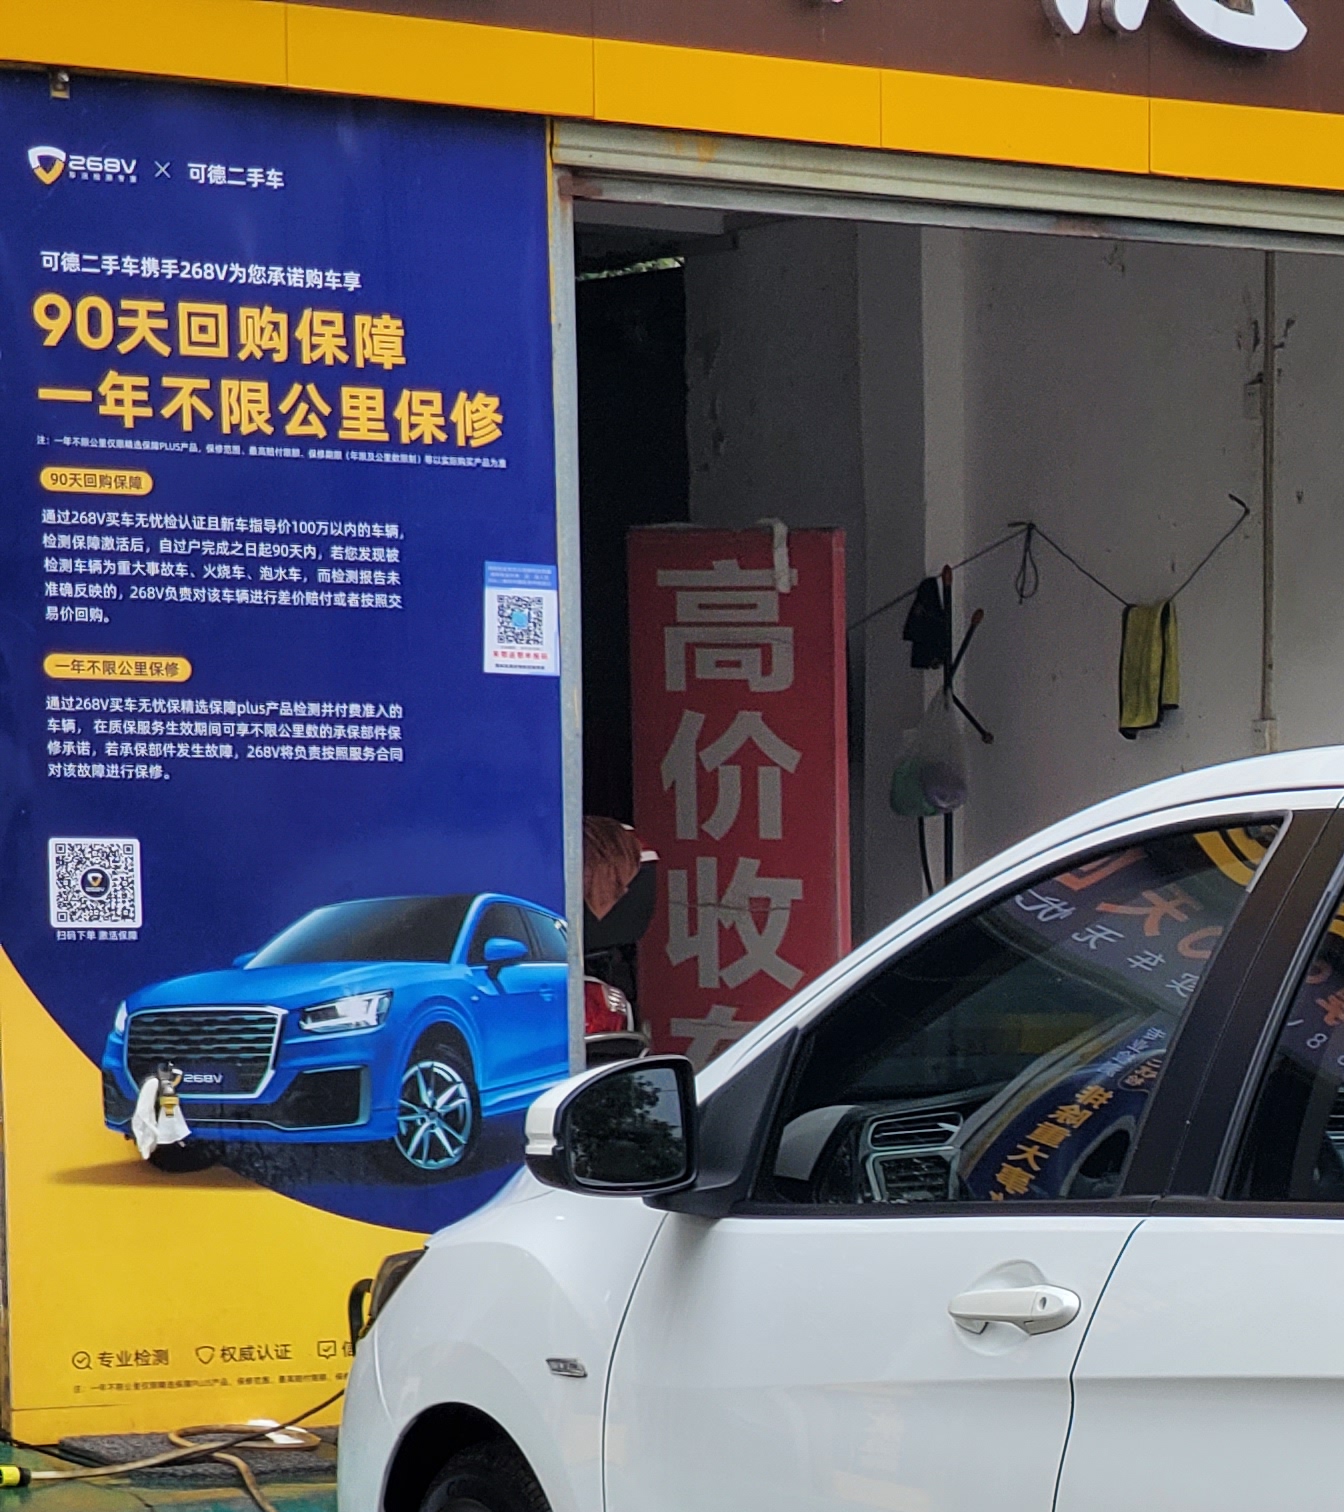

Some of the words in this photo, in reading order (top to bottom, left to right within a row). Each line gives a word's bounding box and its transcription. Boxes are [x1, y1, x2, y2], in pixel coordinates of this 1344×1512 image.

[68, 155, 137, 175] 268V
[187, 162, 285, 189] 可德二手车
[40, 250, 362, 292] 可德二手车携手268V为您承诺购车享
[33, 293, 406, 370] 90天回购保障
[38, 370, 504, 448] 一年不限公里保修
[50, 472, 143, 490] 90天回购保障
[45, 606, 111, 624] 易价回购。
[55, 658, 180, 678] 一年不限公里保修
[47, 762, 171, 780] 对该故障进行保修。
[183, 1072, 223, 1083] 268V
[97, 1349, 170, 1368] 专业检测
[220, 1343, 293, 1363] 权威认证
